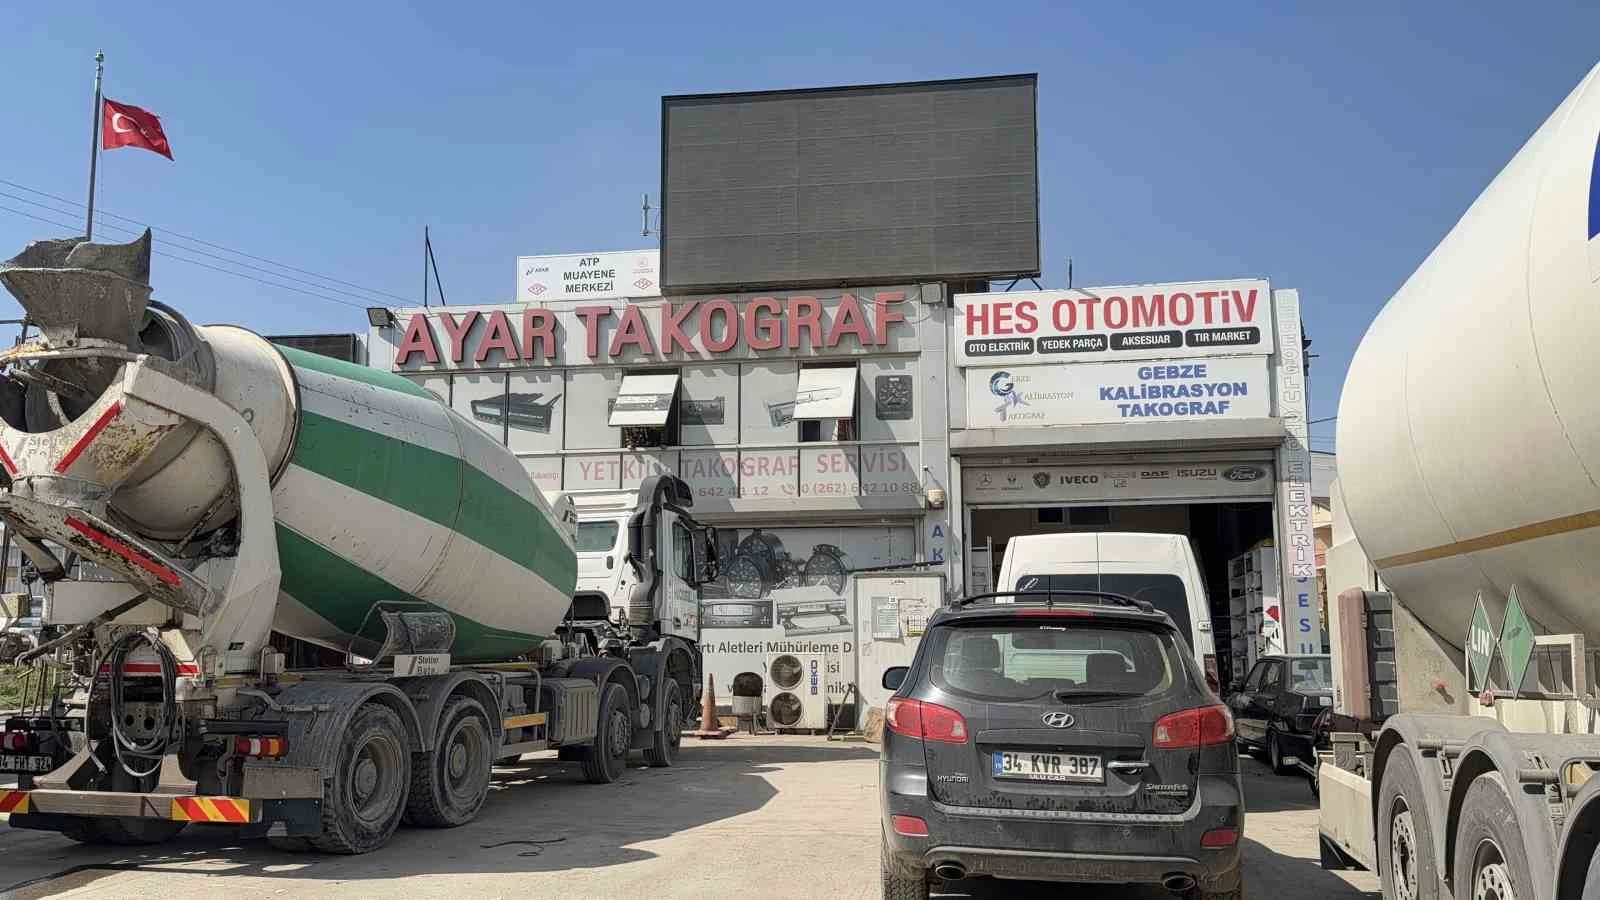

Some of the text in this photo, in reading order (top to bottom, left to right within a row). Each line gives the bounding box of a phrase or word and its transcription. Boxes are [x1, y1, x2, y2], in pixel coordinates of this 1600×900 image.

[579, 257, 600, 267] ATP
[563, 269, 616, 281] MUAYENE
[565, 280, 614, 294] MERKEZİ
[965, 300, 1039, 337] HES
[395, 291, 906, 365] AYAR TAKOGRAF
[1122, 333, 1171, 346] AKSESUAR
[1195, 328, 1251, 343] TIR MARKET
[969, 339, 1030, 353] OTO ELEKTRİK
[1041, 336, 1103, 350] YEDEK PARÇA
[1137, 364, 1207, 381] GEBZE
[1099, 381, 1248, 401] KALİBRASYON
[1116, 400, 1230, 418] TAKOGRAF
[1060, 474, 1099, 485] IVECO
[1176, 468, 1217, 478] ISUZU
[718, 640, 763, 653] Aletleri
[766, 640, 838, 654] Mühürleme
[1003, 753, 1022, 772] 34
[1069, 756, 1099, 776] 387
[936, 775, 969, 783] HYUNDAI
